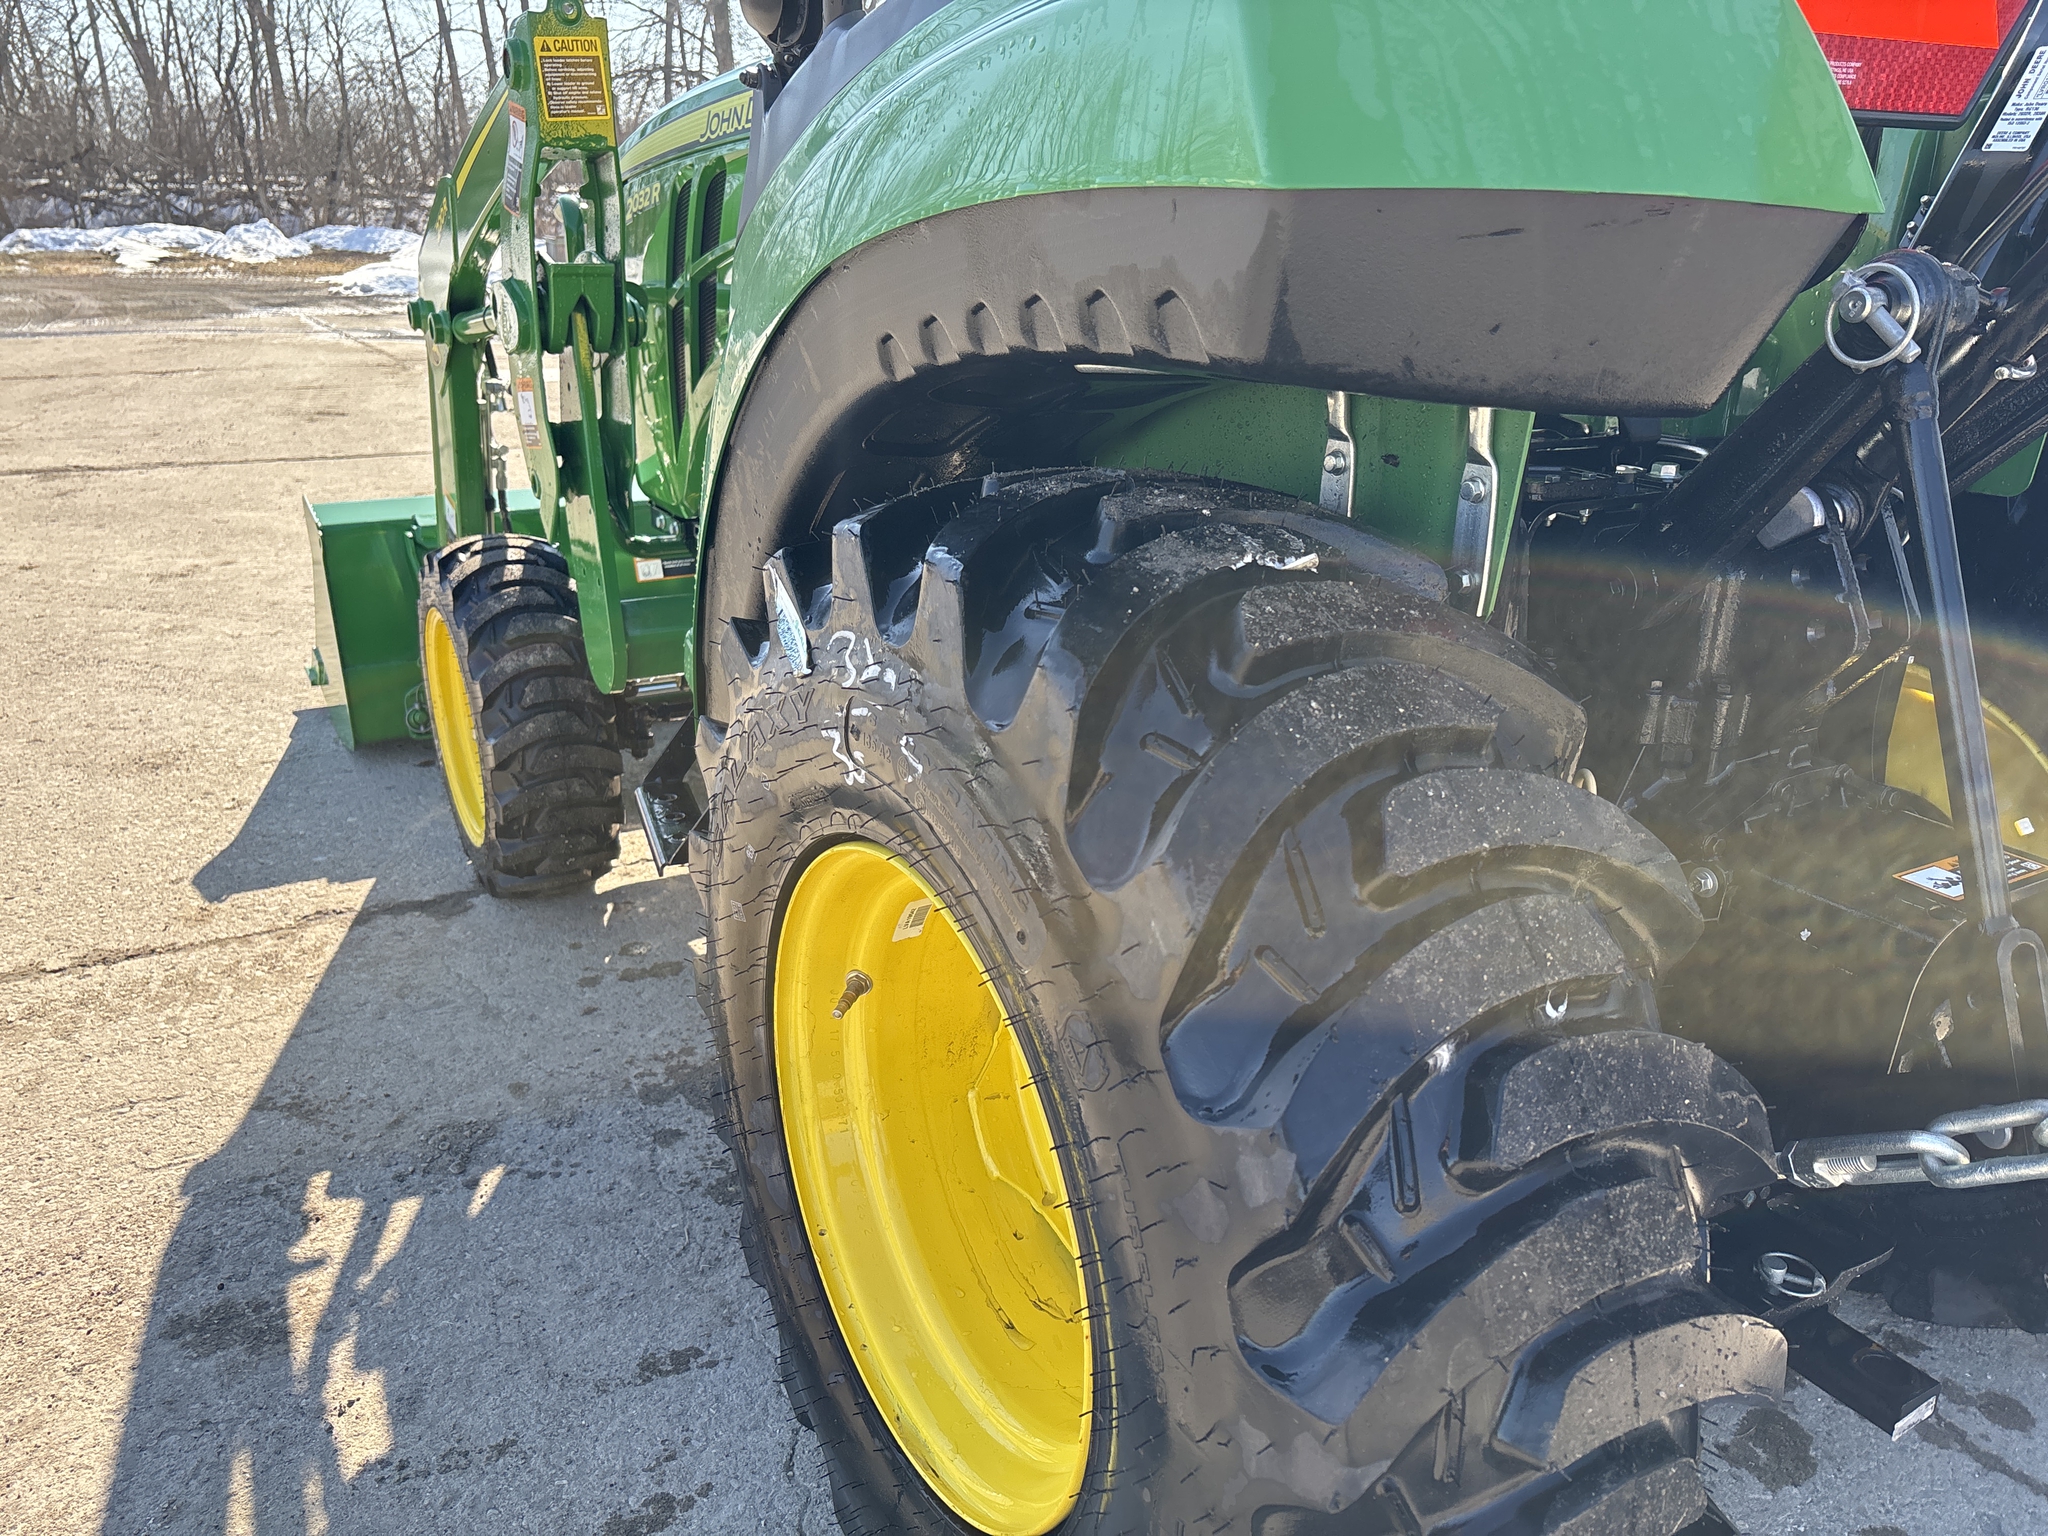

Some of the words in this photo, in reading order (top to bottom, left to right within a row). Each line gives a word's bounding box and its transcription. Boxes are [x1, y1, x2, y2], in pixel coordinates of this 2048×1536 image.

[553, 39, 598, 52] CAUTION
[2015, 78, 2031, 99] JOHN
[2029, 50, 2047, 74] DEERE
[699, 104, 746, 142] JOHN
[626, 182, 661, 221] 2032R
